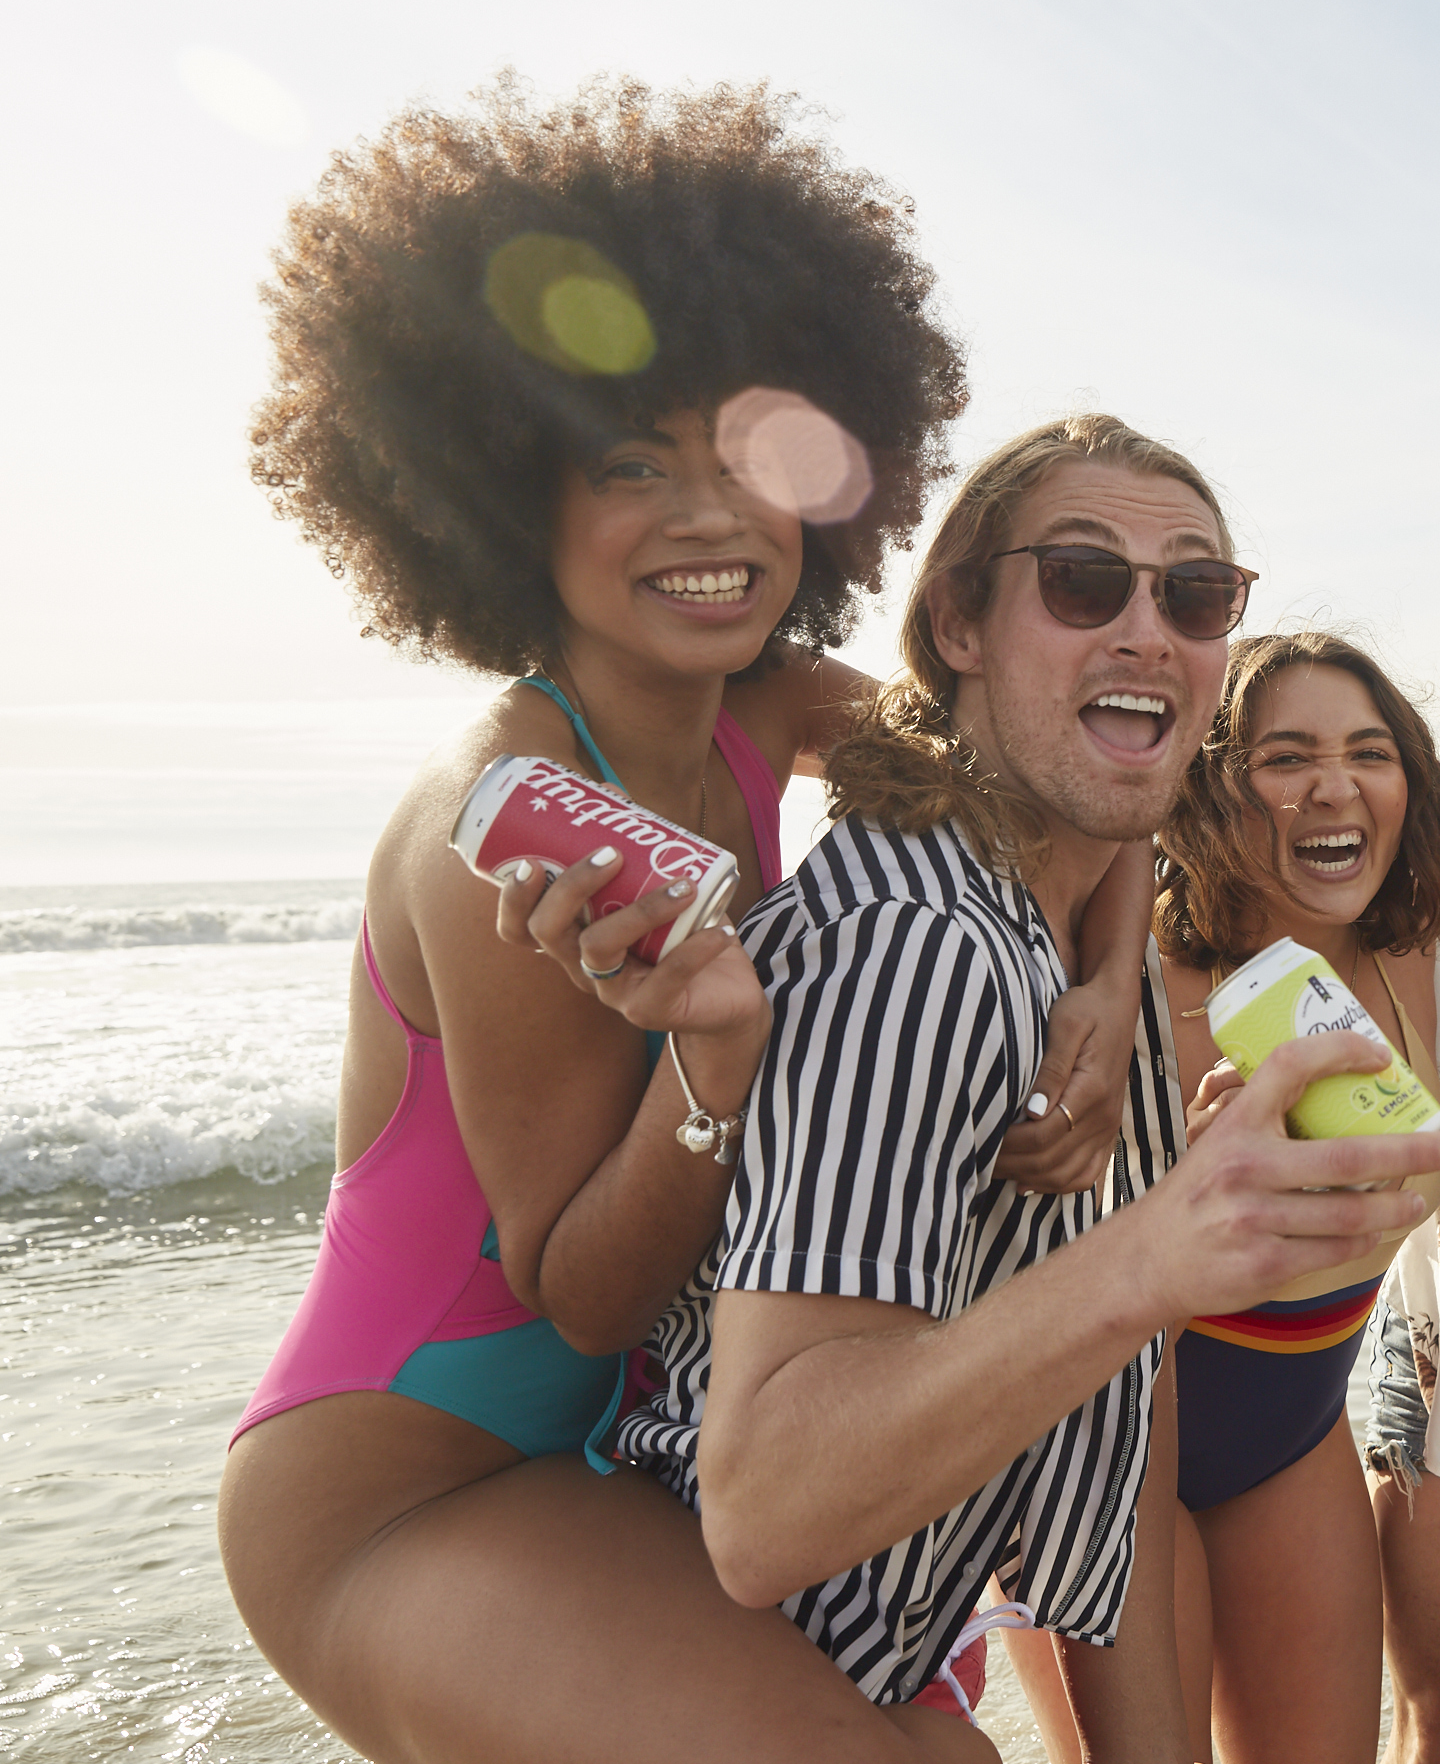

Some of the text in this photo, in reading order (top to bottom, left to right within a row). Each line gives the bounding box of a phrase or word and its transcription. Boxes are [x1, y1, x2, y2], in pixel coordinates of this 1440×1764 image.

[520, 768, 718, 881] Daytrip
[1359, 1093, 1367, 1103] 5
[1378, 1093, 1409, 1118] LEMON
